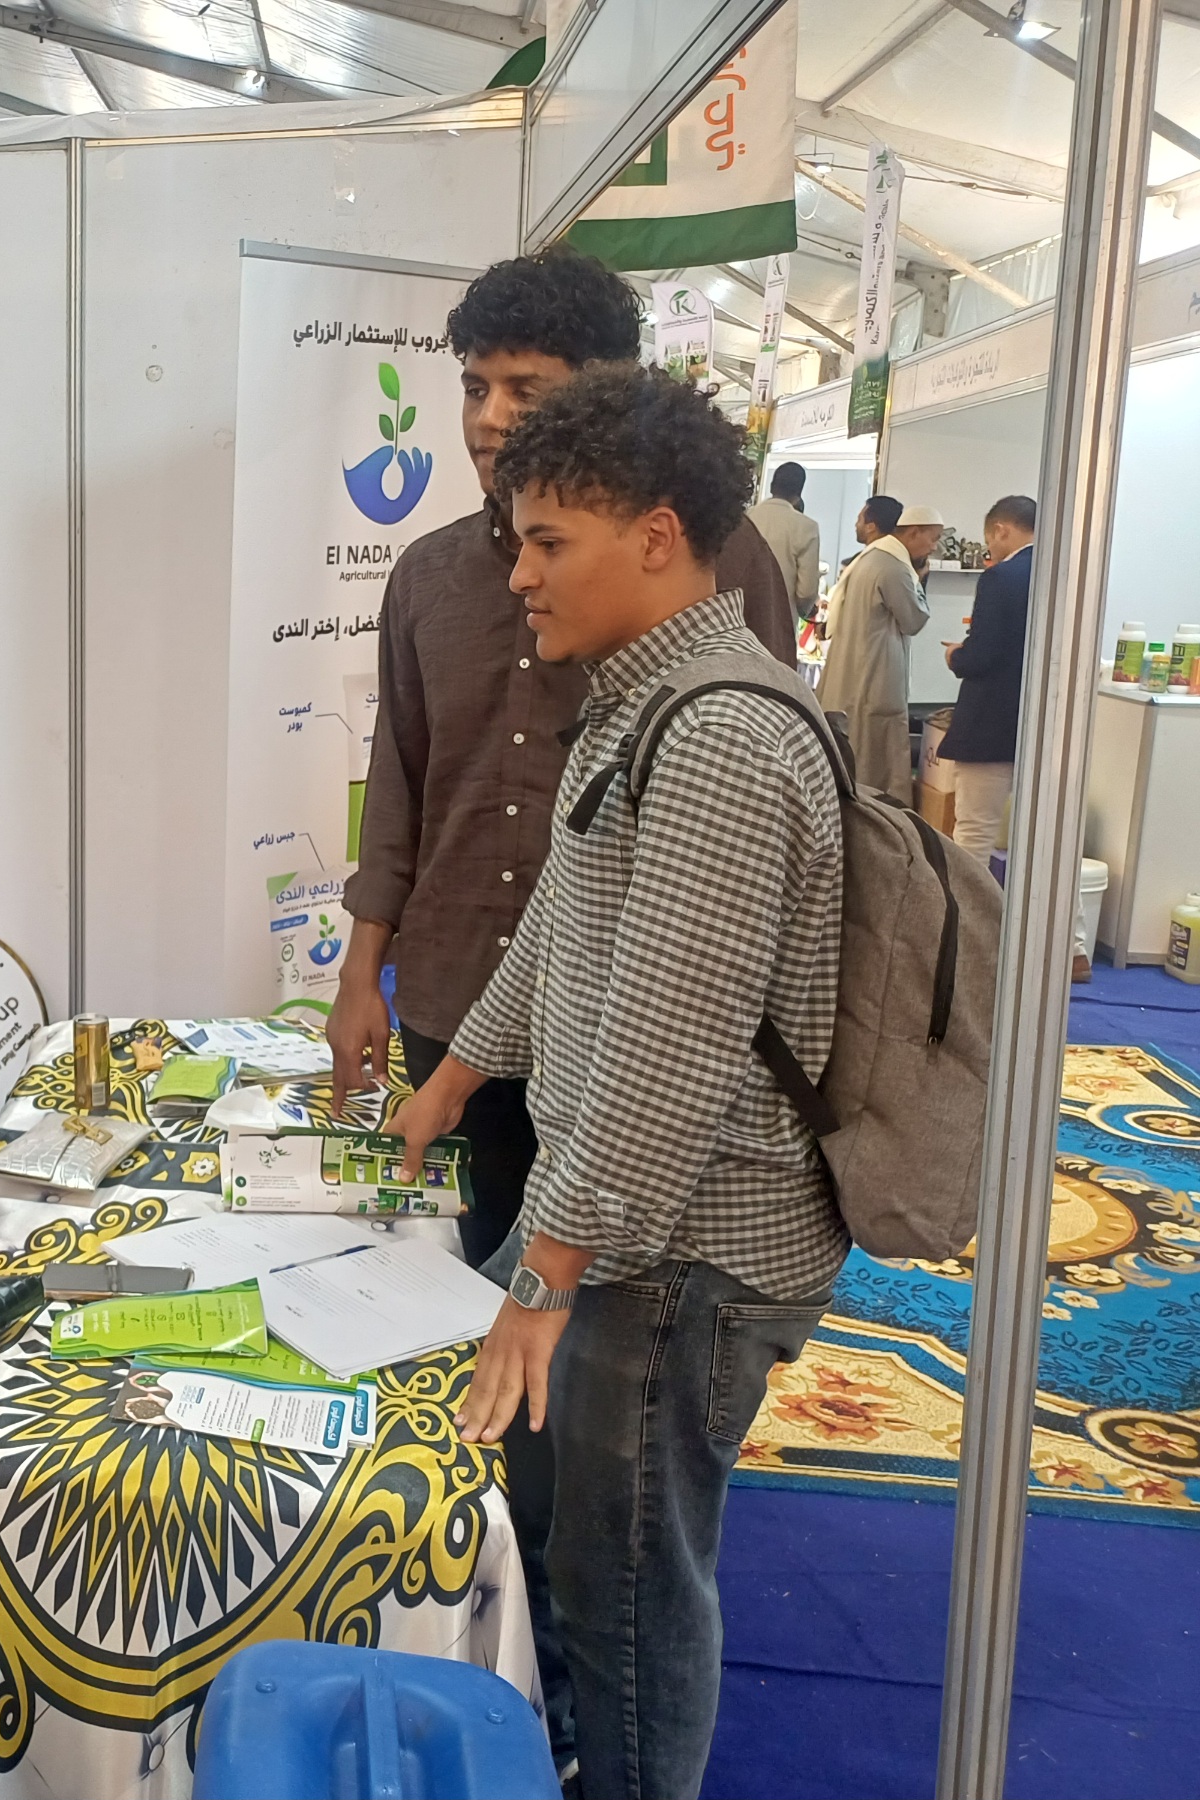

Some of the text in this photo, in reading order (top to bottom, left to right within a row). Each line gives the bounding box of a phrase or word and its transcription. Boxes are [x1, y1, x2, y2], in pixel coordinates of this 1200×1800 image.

[293, 320, 449, 354] جروب للإستثمار الزراعي
[347, 545, 392, 564] NADA
[340, 570, 386, 582] Agricultural
[273, 618, 308, 642] الندى
[311, 616, 340, 641] إختر
[279, 702, 312, 716] كمبوست
[287, 722, 302, 733] بودر
[253, 832, 295, 850] جبس زراعي
[276, 885, 305, 904] الندى
